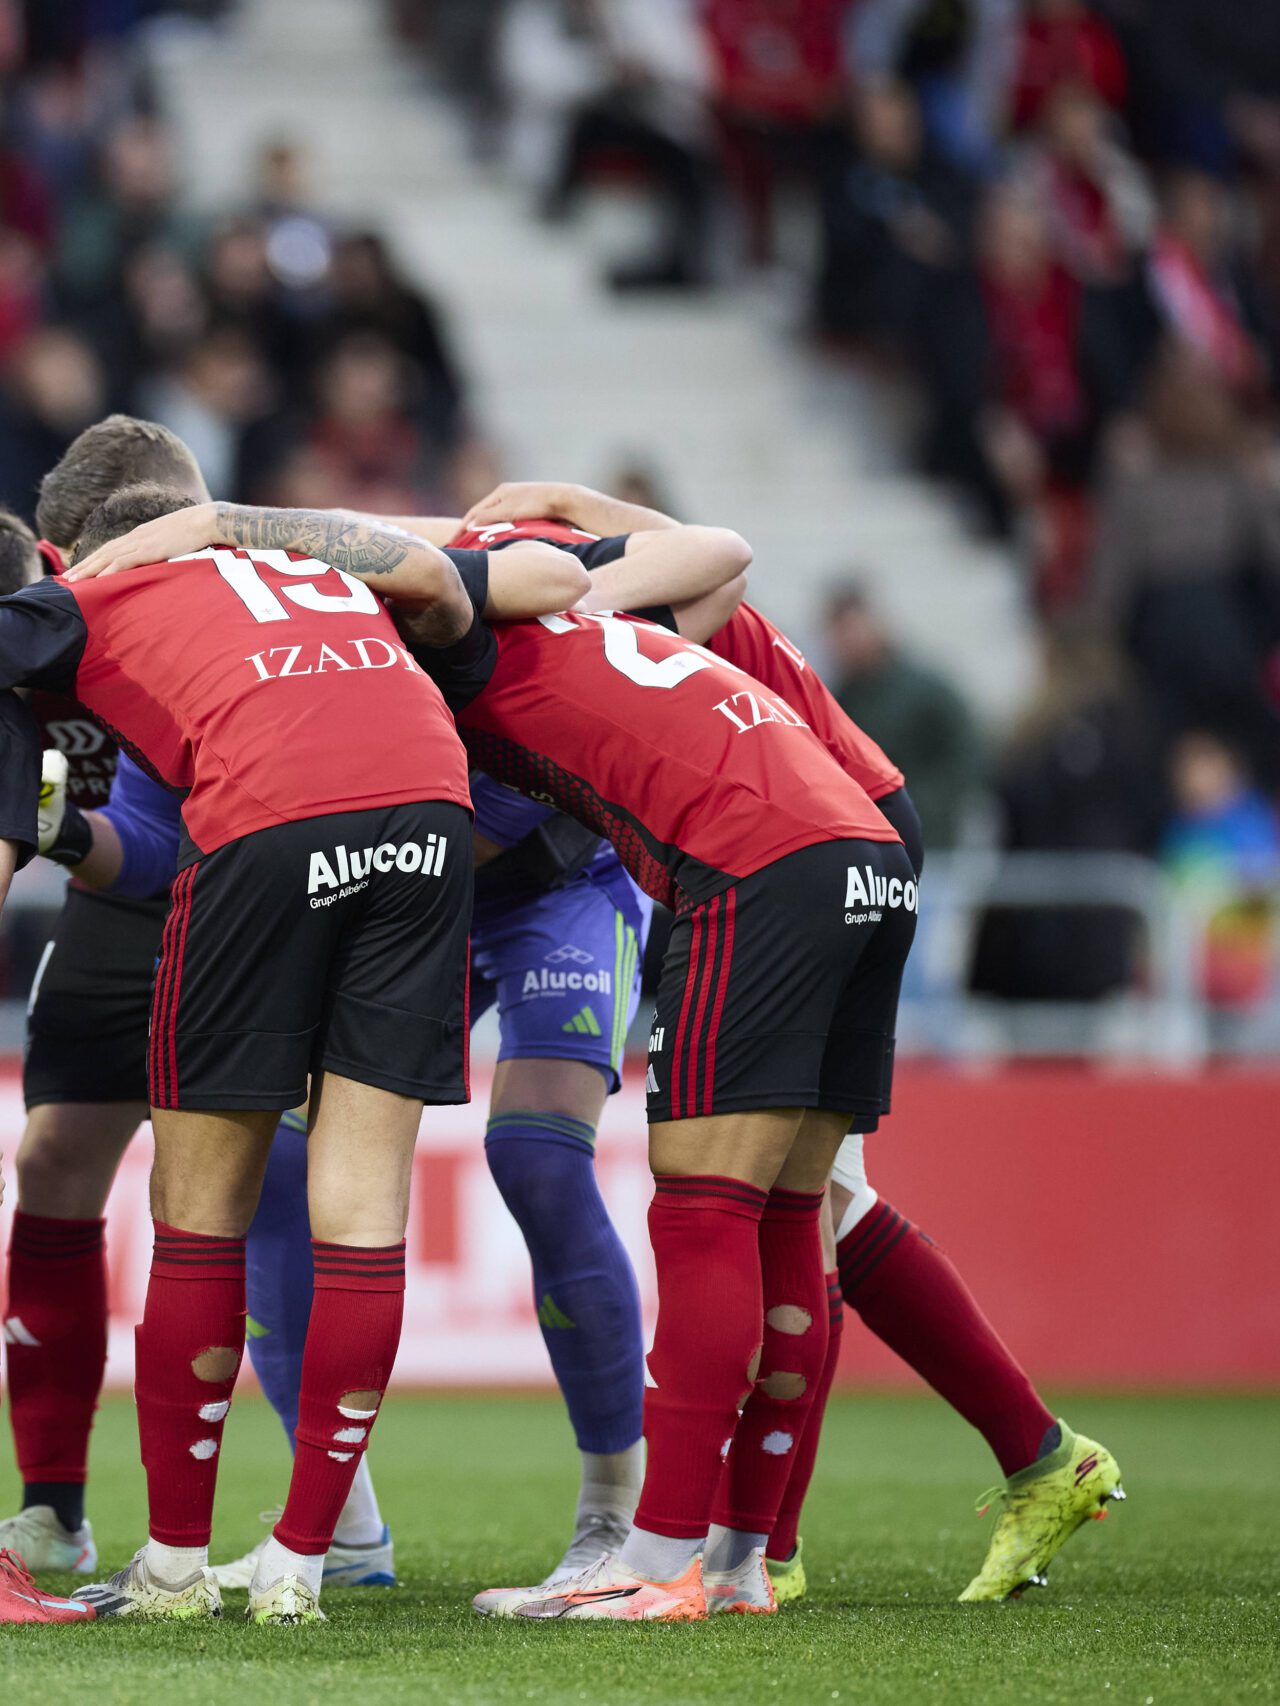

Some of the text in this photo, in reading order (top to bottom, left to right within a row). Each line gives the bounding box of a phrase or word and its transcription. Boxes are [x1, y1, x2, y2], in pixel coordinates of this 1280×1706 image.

[168, 546, 380, 623] 15
[245, 637, 422, 682] IZADI
[307, 833, 448, 895] Alucoil
[309, 894, 338, 909] Grupo
[844, 865, 919, 915] Alucoi
[845, 912, 868, 925] Grupo
[522, 968, 611, 995] Alucoil
